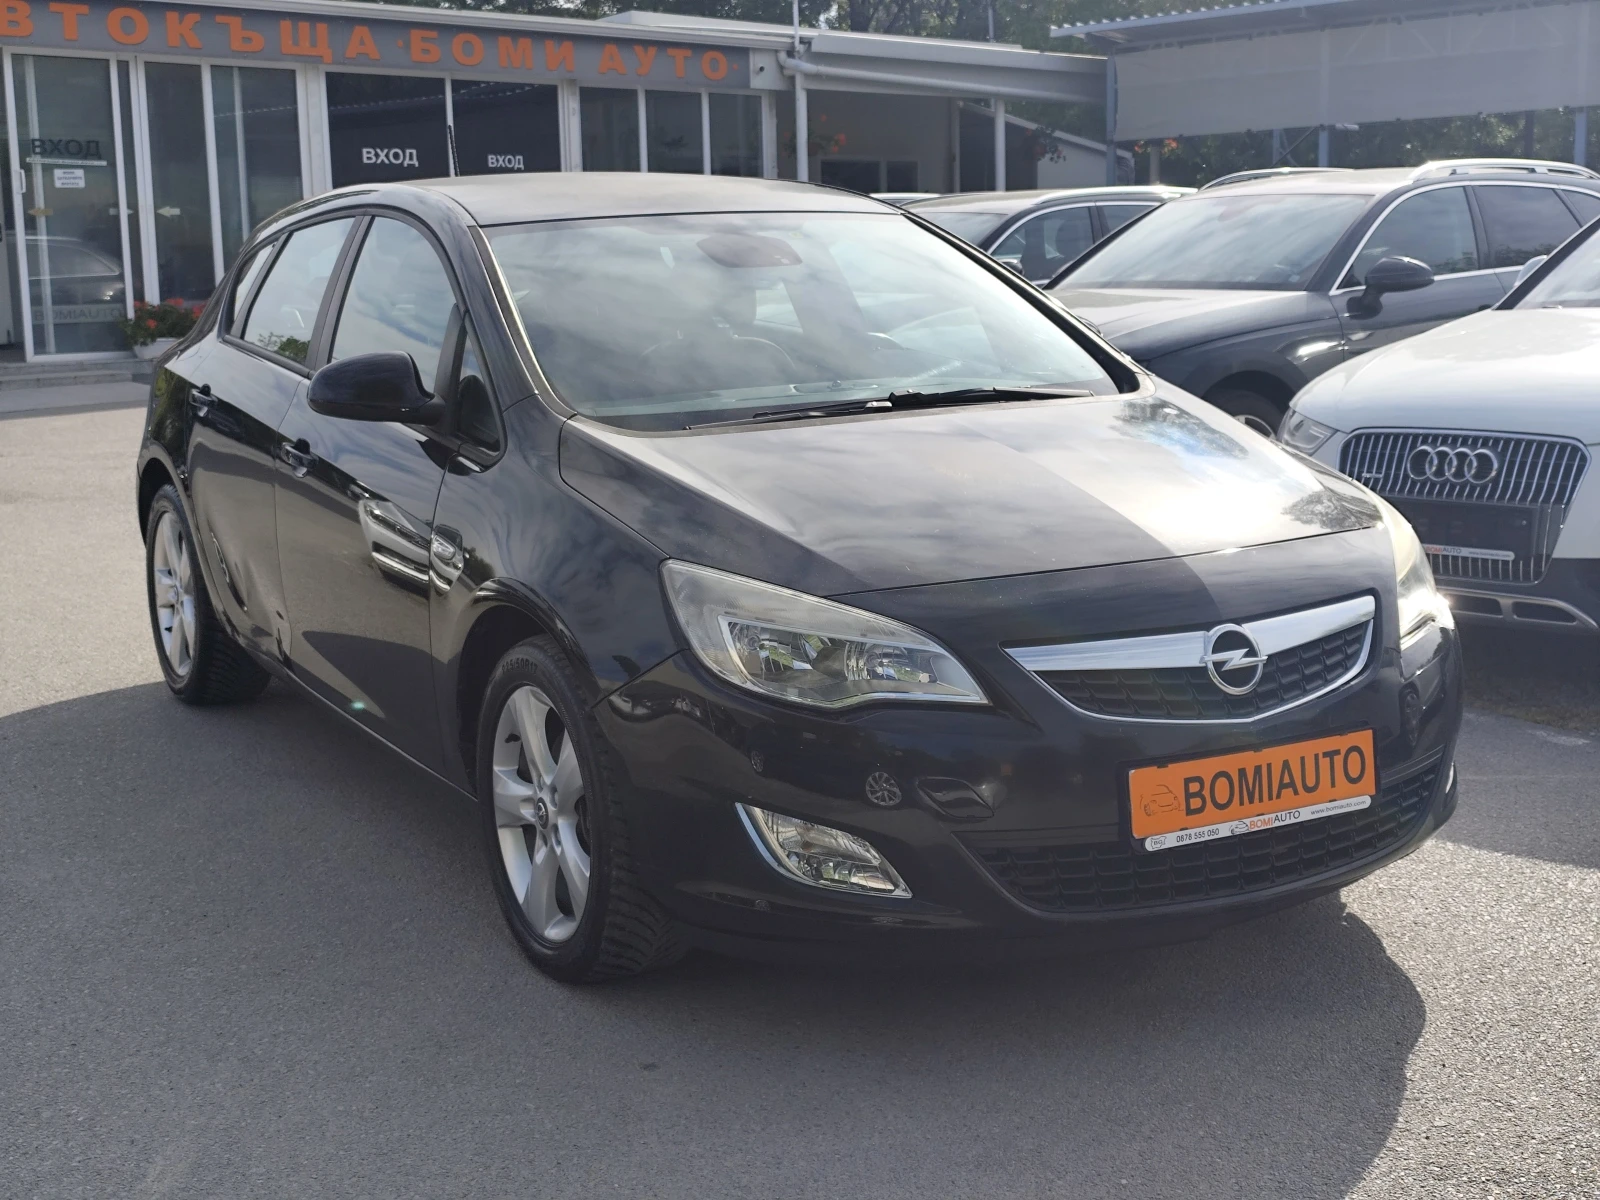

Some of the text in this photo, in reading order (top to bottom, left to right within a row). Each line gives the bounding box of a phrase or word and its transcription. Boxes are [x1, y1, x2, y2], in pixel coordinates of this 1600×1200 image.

[410, 29, 575, 73] БОМИ
[598, 43, 728, 81] АУТО
[32, 139, 102, 160] ВХОД
[362, 148, 418, 167] ВХОД
[487, 154, 525, 170] ВХОД
[1183, 745, 1367, 817] BOMIAUTO
[1310, 800, 1367, 816] www.bomiauto.com
[1249, 810, 1301, 830] BOMIAUTO
[1176, 828, 1220, 843] 0878 555 050
